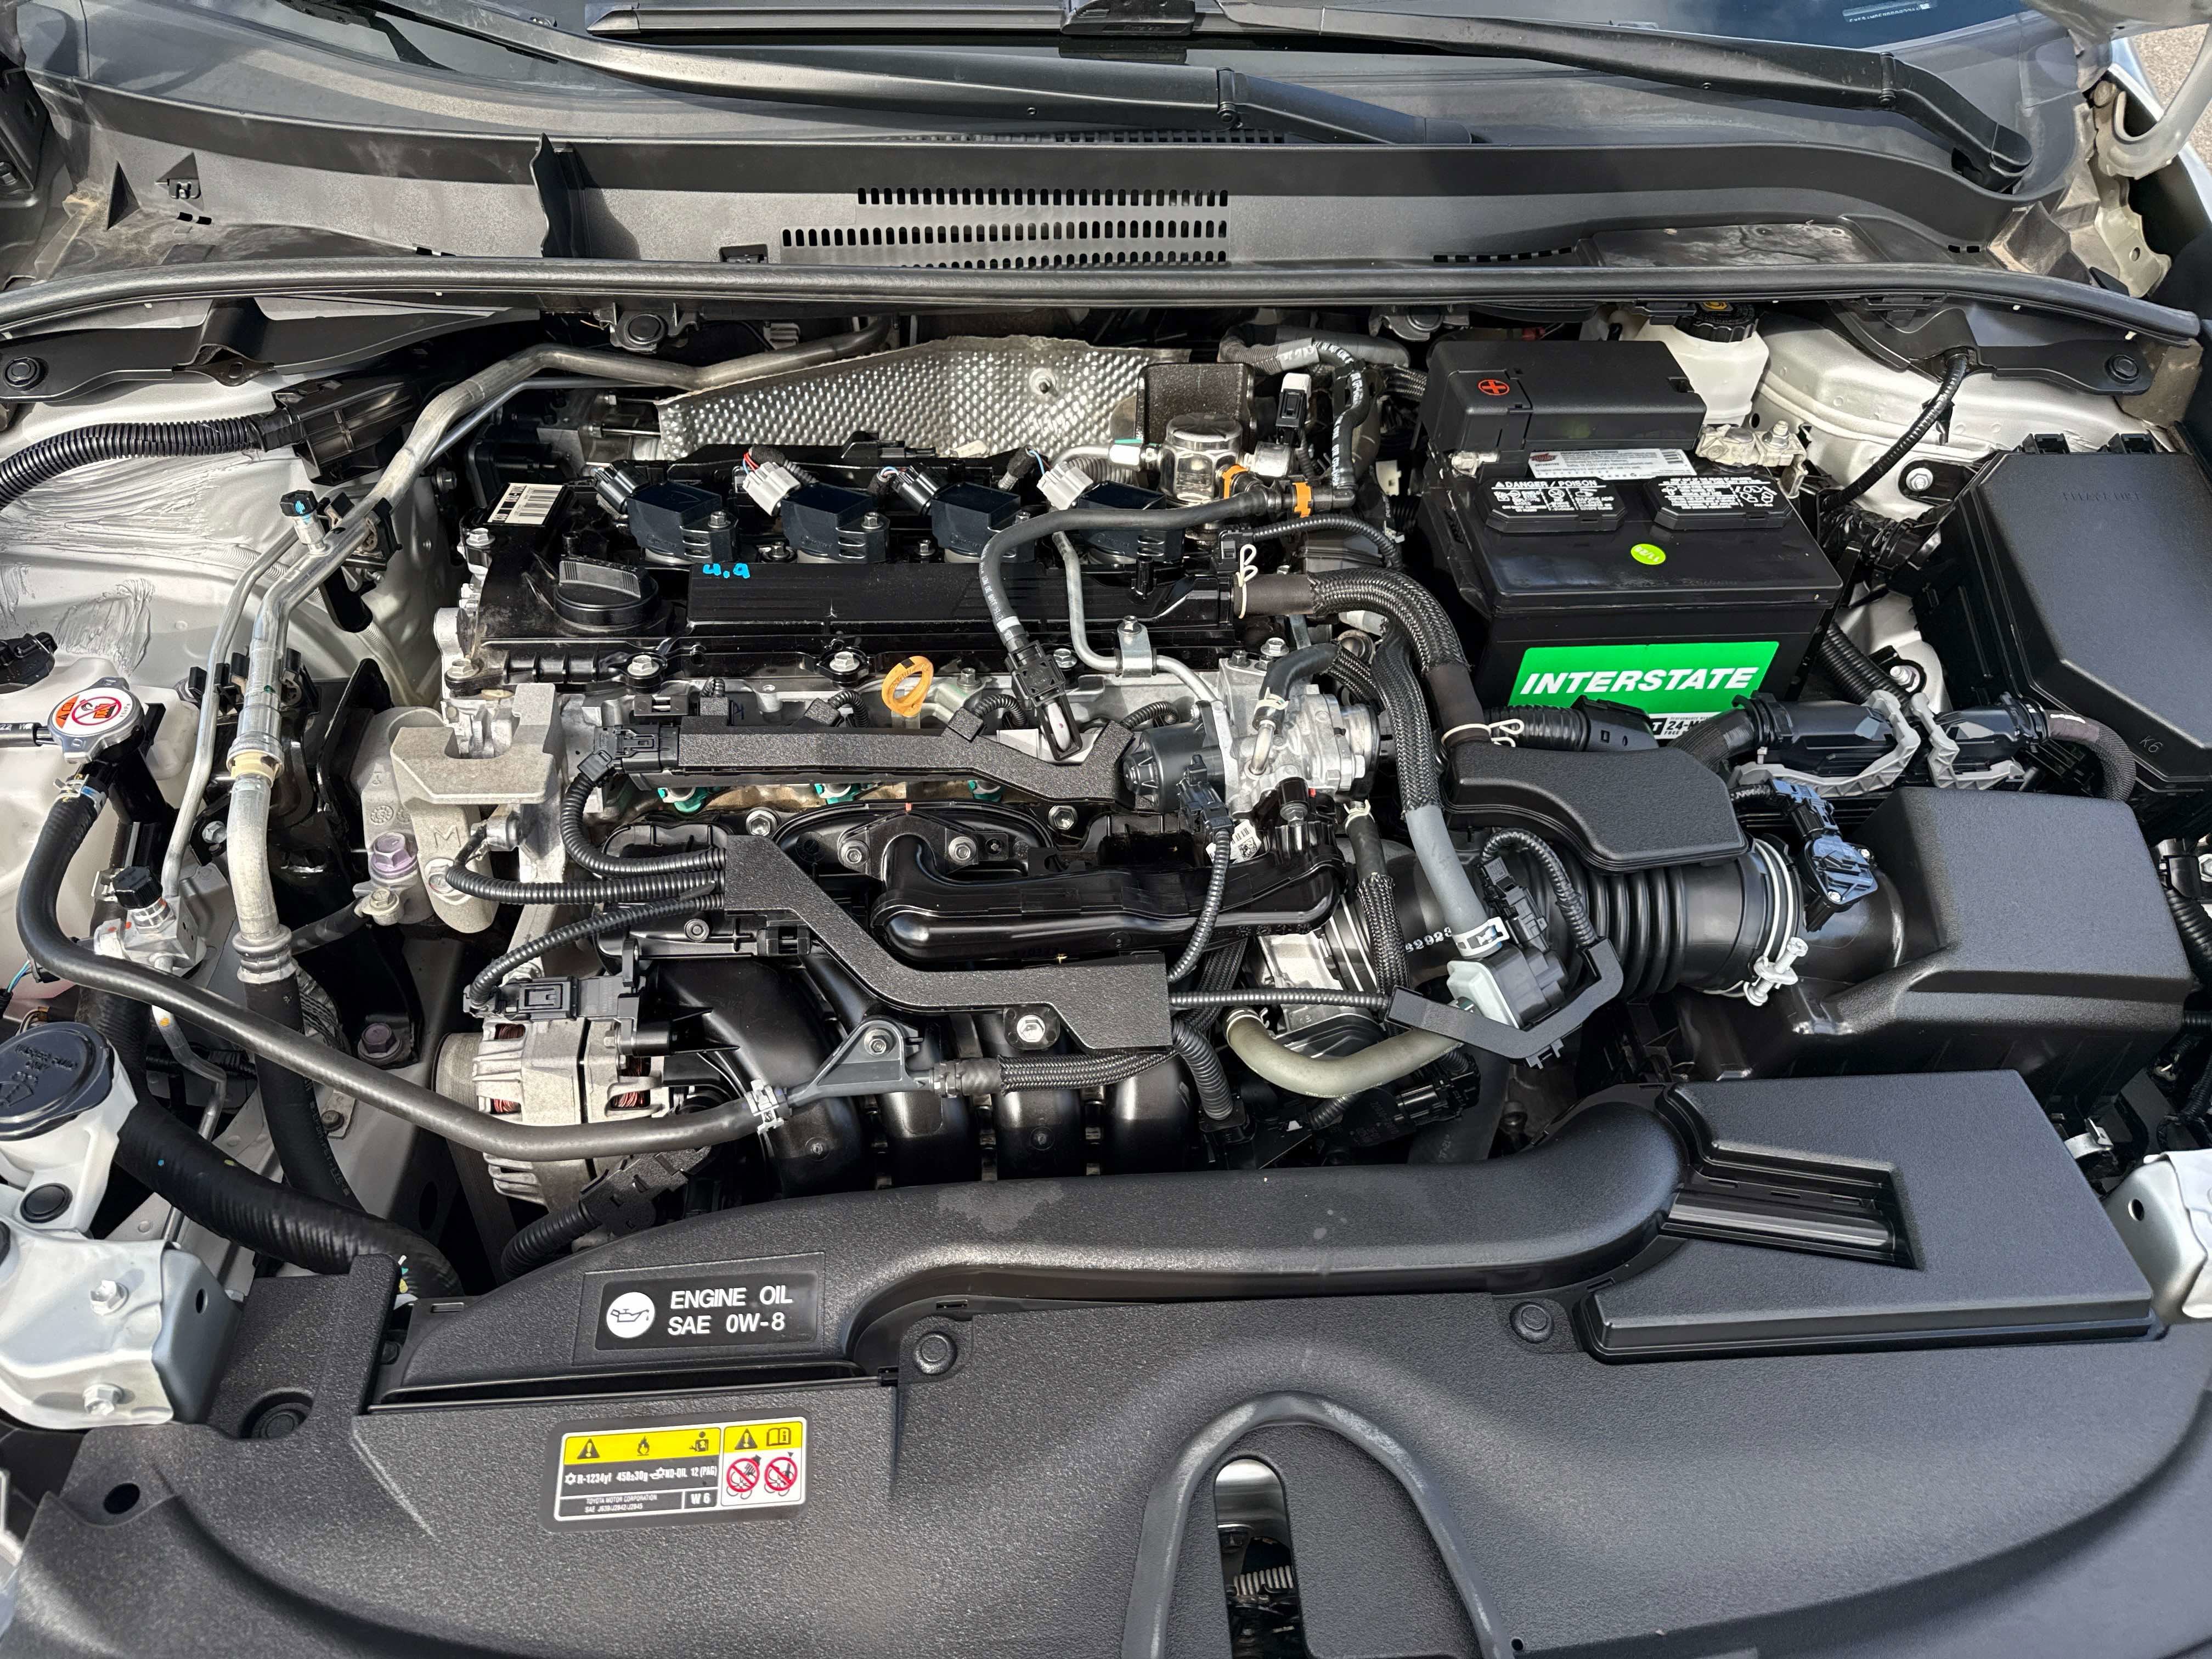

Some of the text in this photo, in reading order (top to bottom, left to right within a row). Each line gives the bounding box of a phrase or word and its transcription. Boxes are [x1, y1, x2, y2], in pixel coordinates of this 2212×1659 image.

[1520, 667, 1759, 695] INTERSTATE
[670, 1285, 794, 1310] ENGINE OIL
[667, 1312, 786, 1336] SAE 0W-8
[577, 1472, 612, 1485] R-1234yf
[691, 1467, 698, 1476] 12
[691, 1492, 711, 1504] W 6
